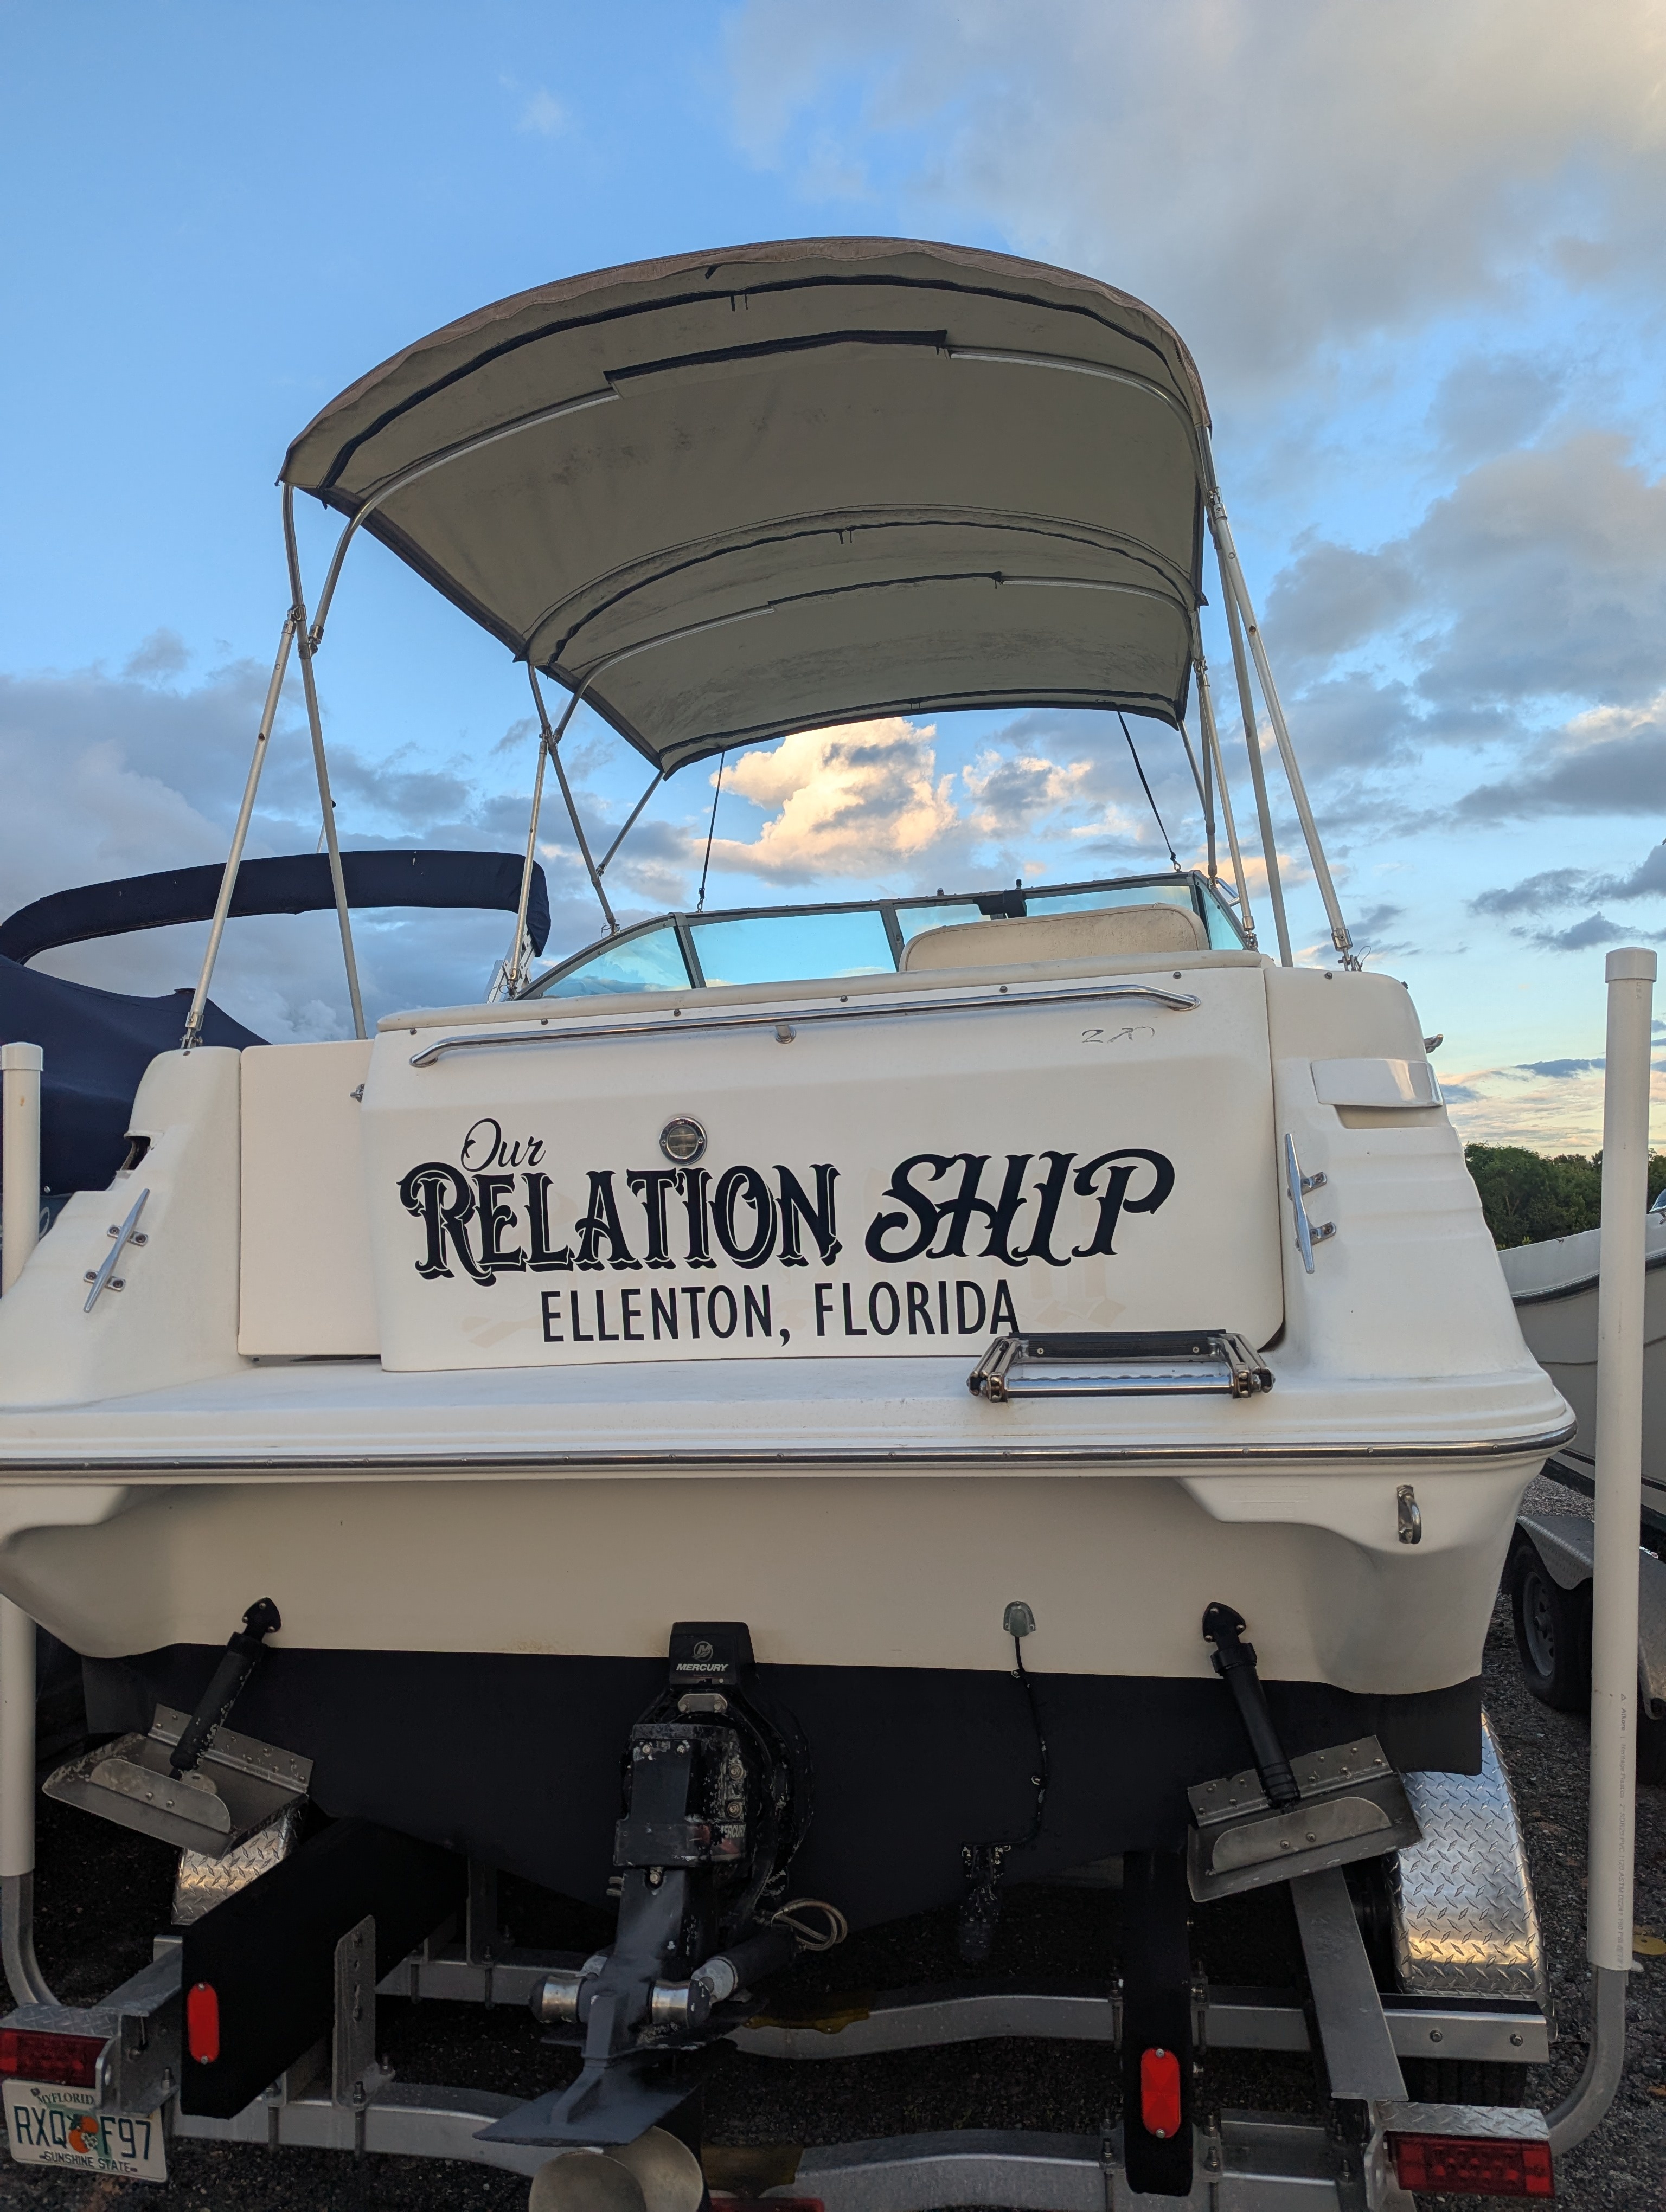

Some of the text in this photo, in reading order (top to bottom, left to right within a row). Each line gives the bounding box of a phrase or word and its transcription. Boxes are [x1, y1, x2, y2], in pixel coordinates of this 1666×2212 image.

[460, 1118, 547, 1172] Our
[399, 1148, 1176, 1286] RELATION SHIP
[541, 1279, 1020, 1347] ELLENTON, FLORIDA
[676, 1663, 729, 1672] MERCURY
[44, 2150, 131, 2172] SUNSHINE STATE
[100, 2115, 151, 2160] F97
